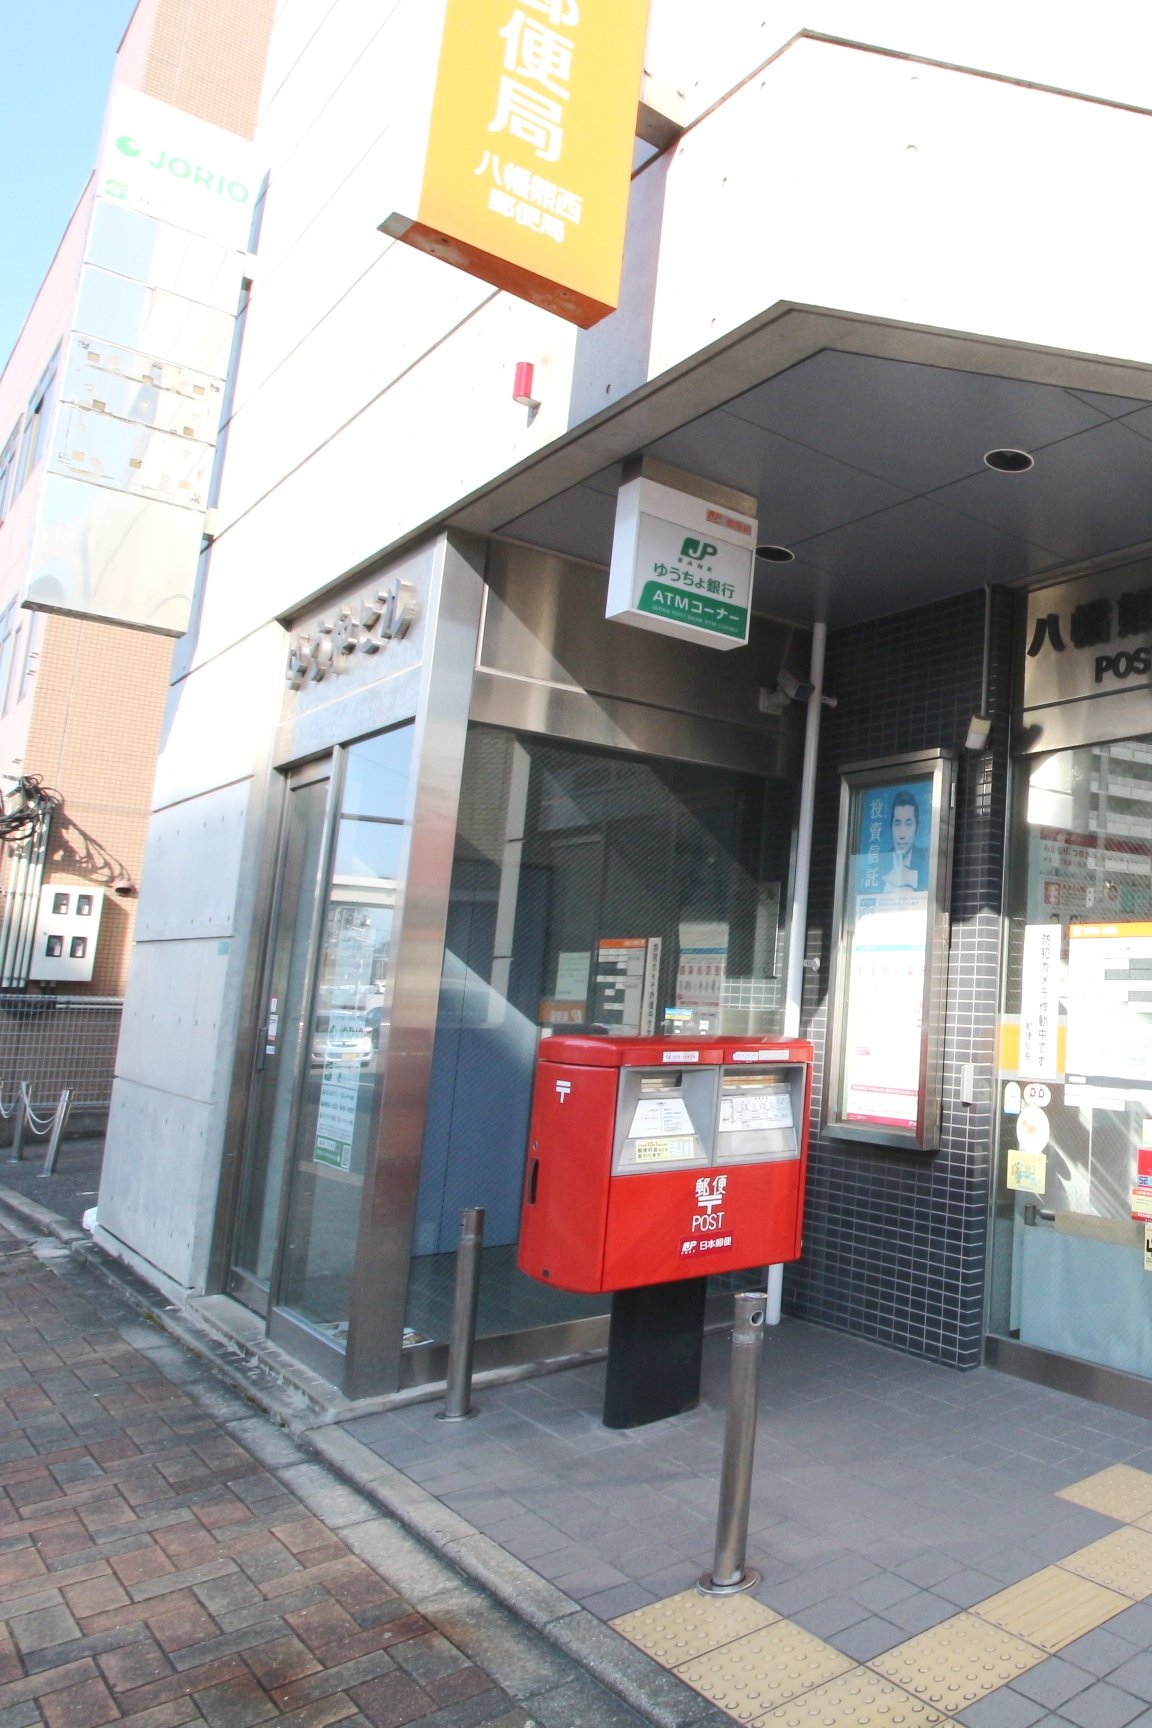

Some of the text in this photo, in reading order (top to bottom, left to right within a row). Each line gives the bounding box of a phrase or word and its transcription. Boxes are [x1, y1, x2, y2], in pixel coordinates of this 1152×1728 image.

[148, 151, 249, 202] JORIO
[474, 150, 584, 225] 八幡熊西
[487, 188, 565, 243] 郵便局
[678, 557, 713, 573] BANK
[681, 537, 718, 561] JP
[654, 562, 735, 599] ゆうちょ銀行
[653, 590, 740, 621] ATMコーナー
[865, 799, 884, 888] 投資信託
[1038, 933, 1051, 1067] 防犯カメラ作動中です
[695, 1175, 728, 1197] 郵便
[691, 1212, 725, 1232] POST
[700, 1236, 732, 1250] 日本郵便
